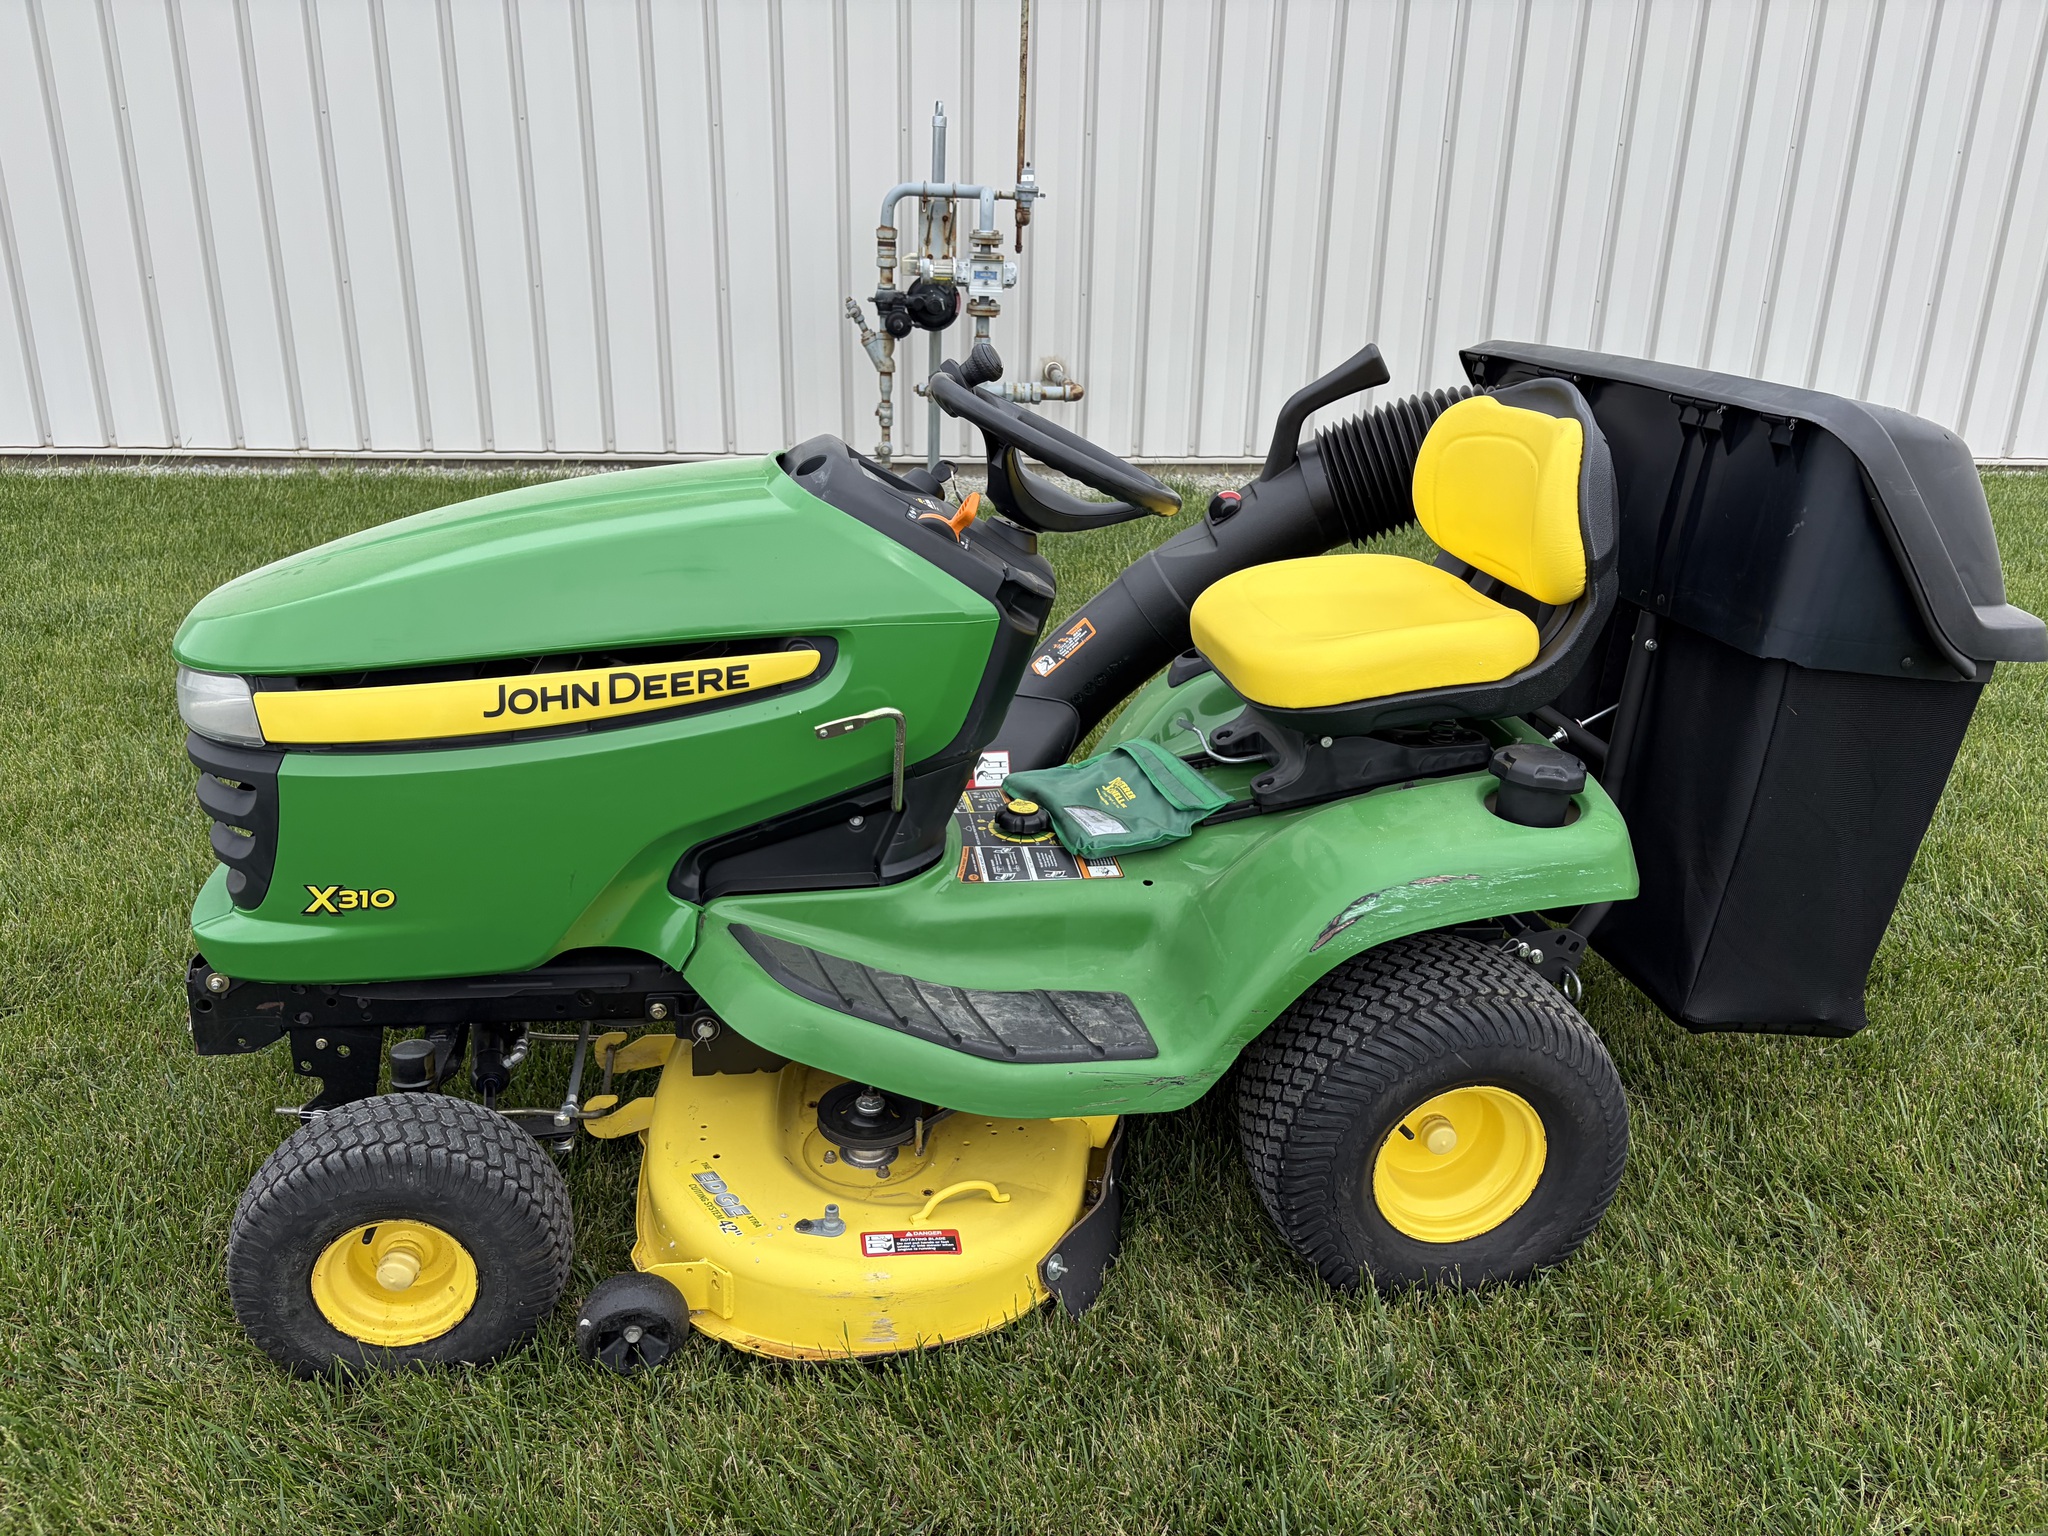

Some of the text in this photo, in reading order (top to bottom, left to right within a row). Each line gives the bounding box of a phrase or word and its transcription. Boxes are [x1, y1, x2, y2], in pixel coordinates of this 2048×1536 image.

[483, 664, 750, 718] JOHN DEERE
[301, 885, 397, 915] X310
[701, 1161, 713, 1170] THE
[688, 1183, 743, 1236] CUTTING SYSTEM 42"
[691, 1170, 763, 1229] EDGE XTRA
